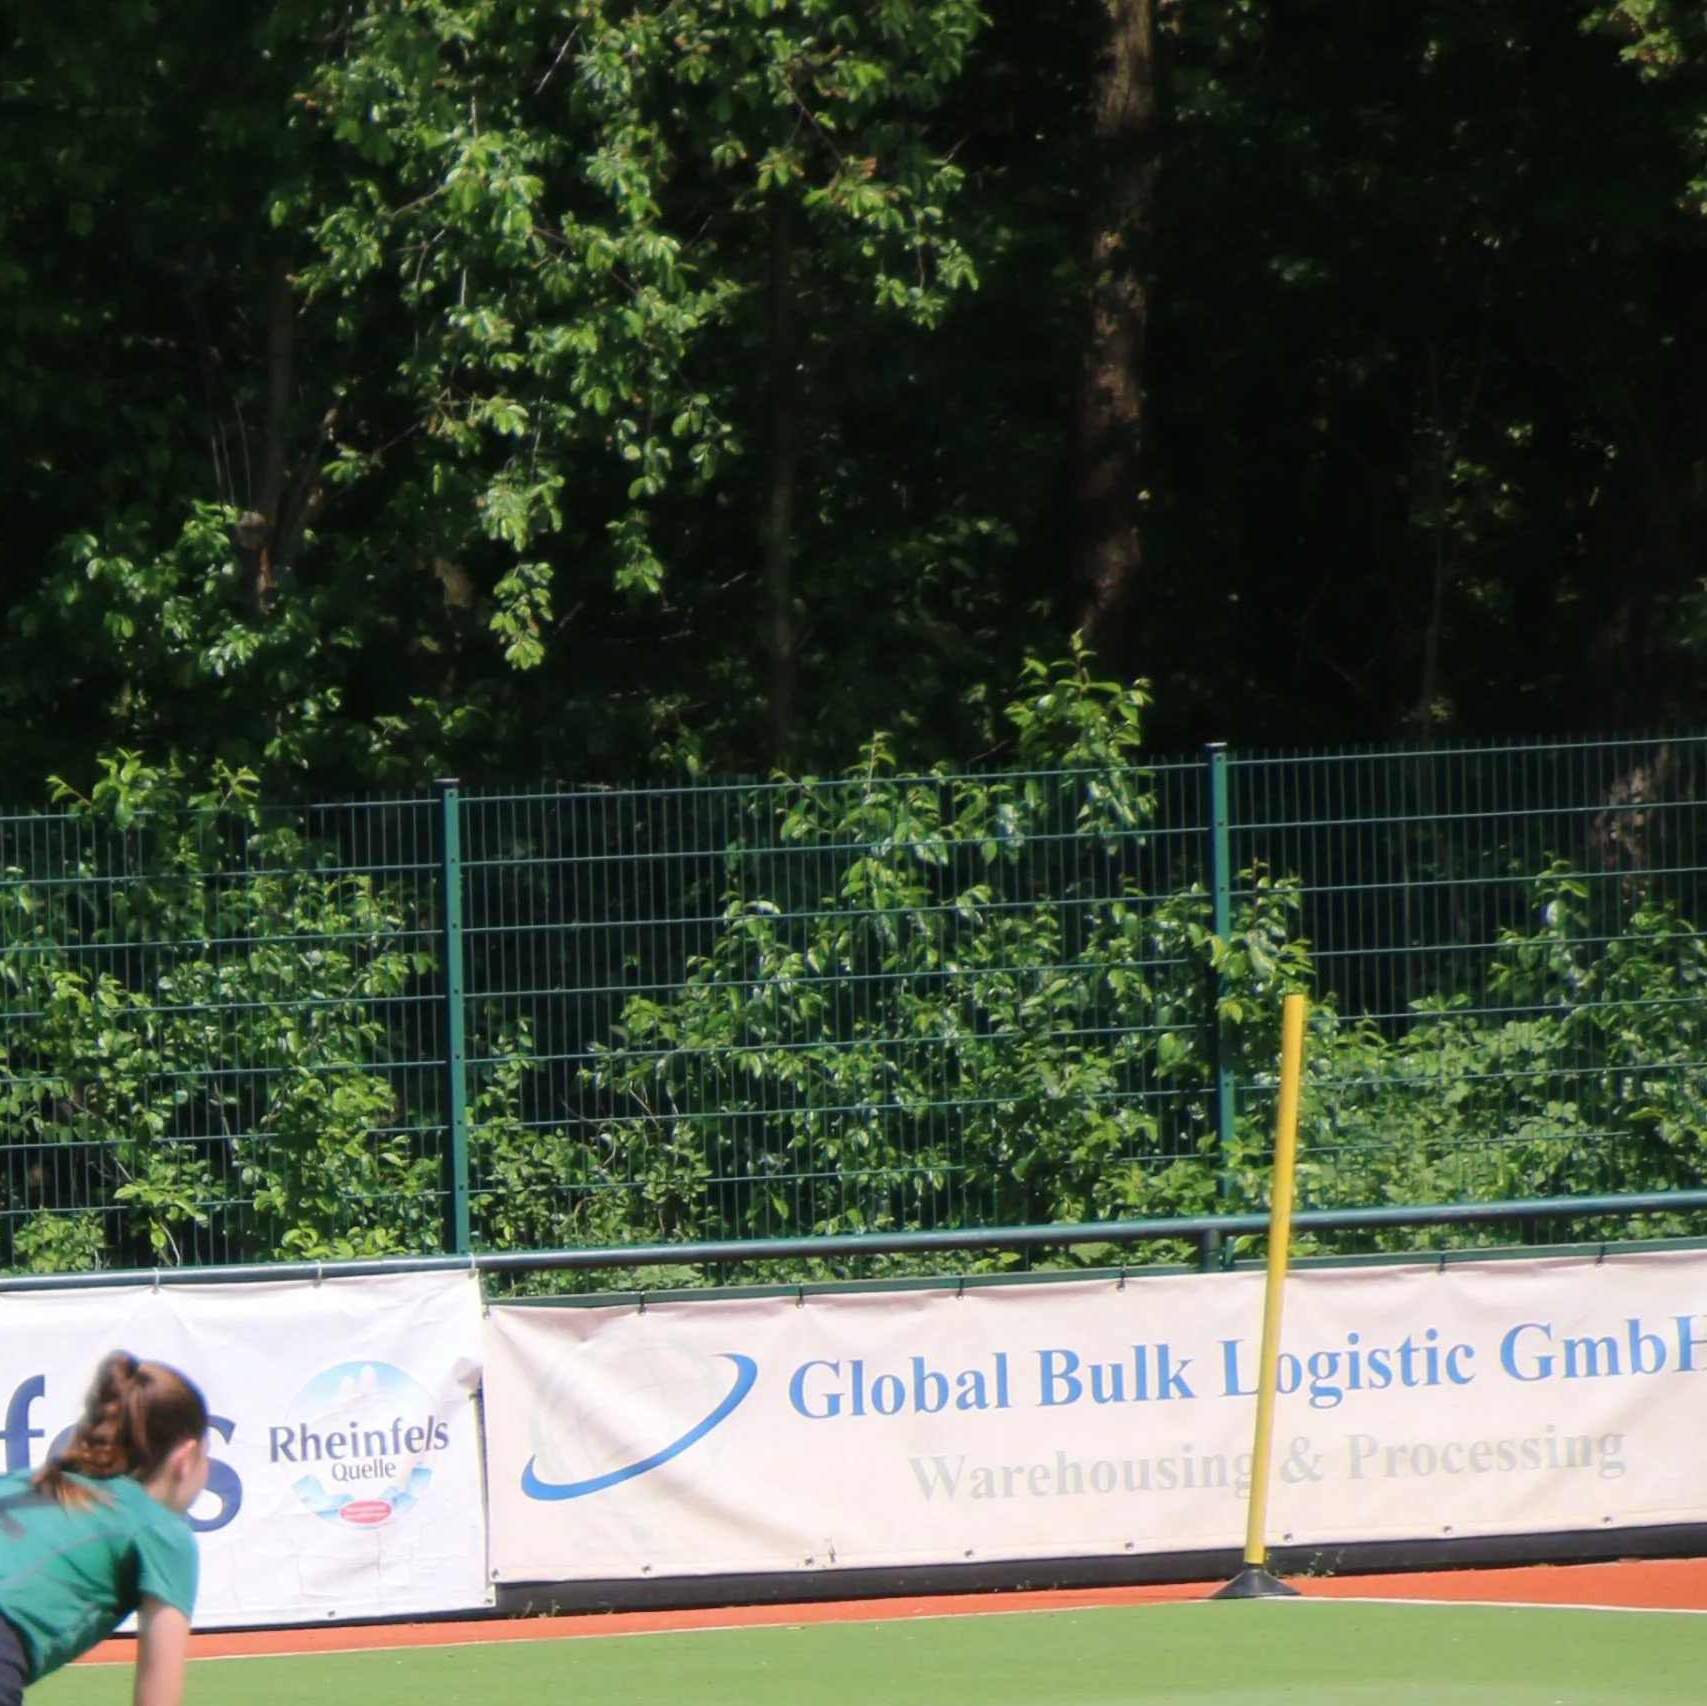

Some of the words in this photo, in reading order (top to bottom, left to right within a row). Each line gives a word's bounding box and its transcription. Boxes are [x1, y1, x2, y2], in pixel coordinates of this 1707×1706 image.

[788, 1352, 1013, 1420] Global
[1033, 1342, 1198, 1408] Bulk
[1218, 1327, 1477, 1410] Logistic
[1499, 1314, 1707, 1384] GmbH
[269, 1415, 451, 1464] Rheinfels
[330, 1458, 398, 1483] Quelle
[907, 1442, 1255, 1500] Warehousing
[1278, 1435, 1325, 1485] &
[1344, 1423, 1629, 1480] Processing
